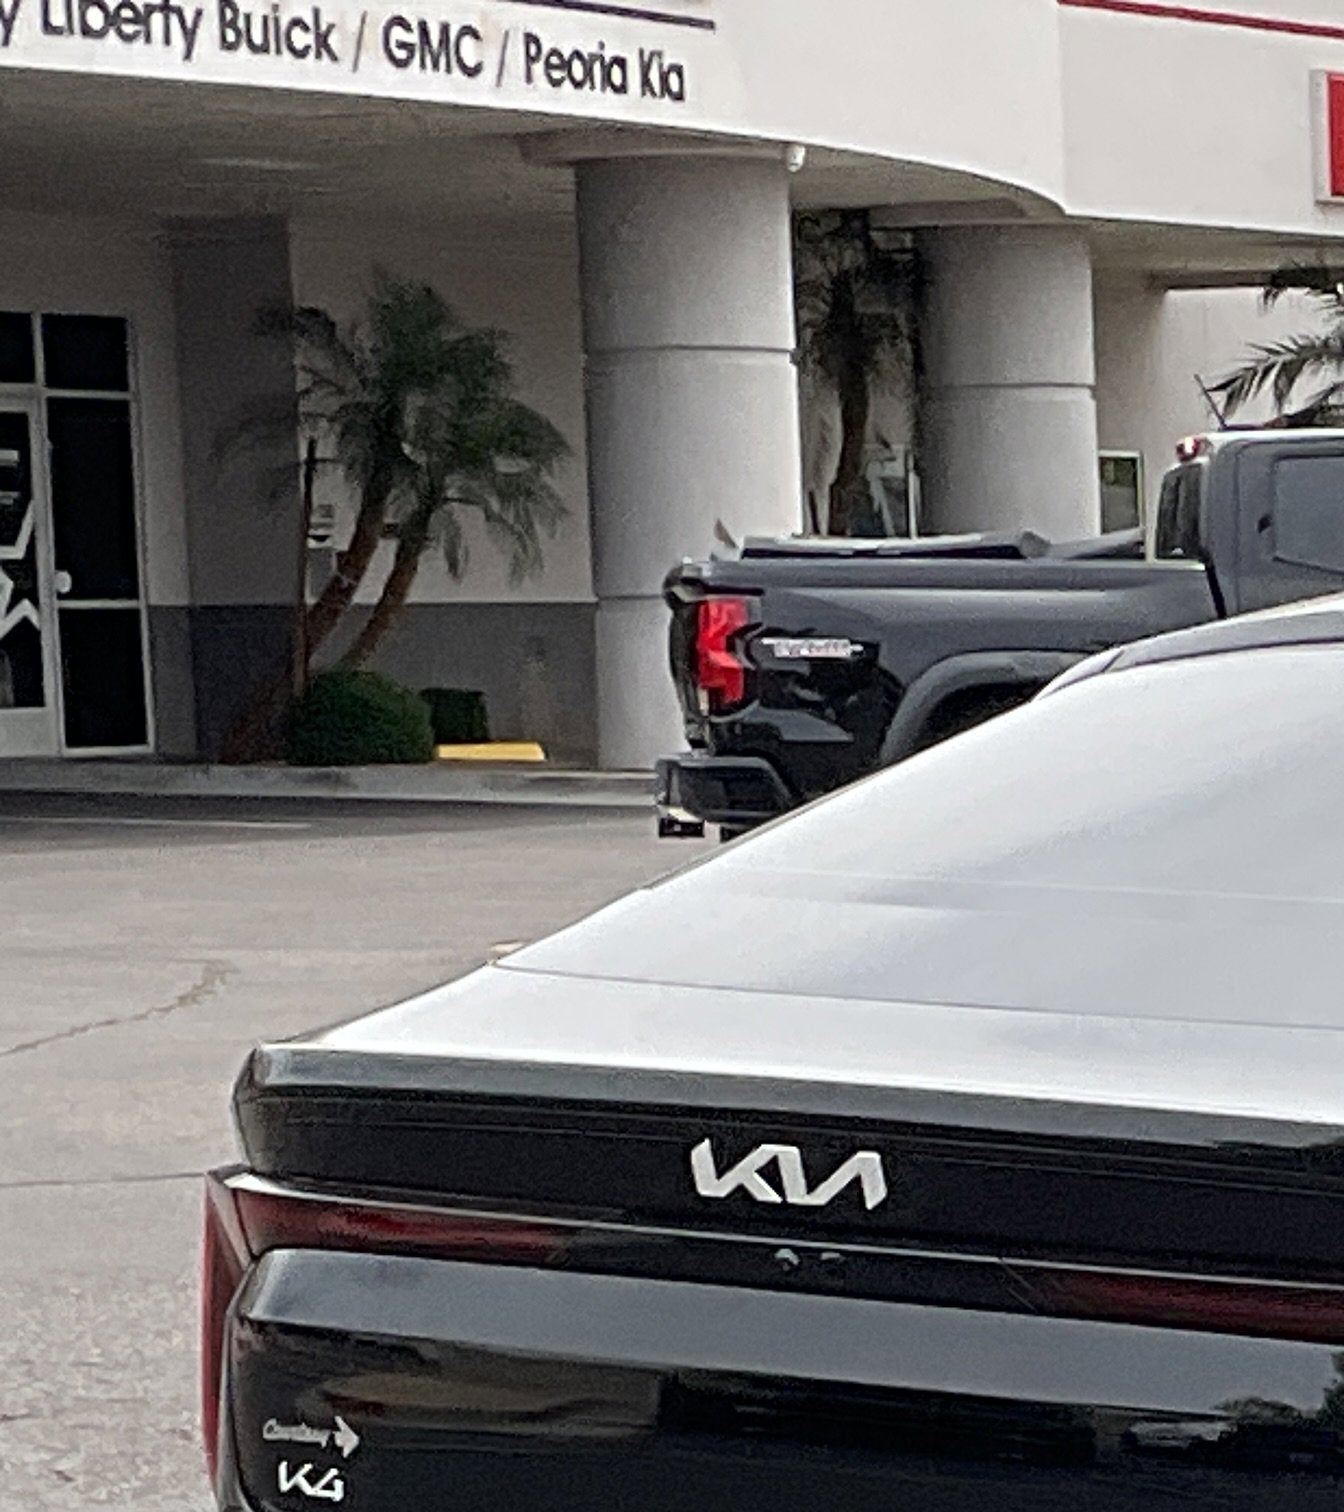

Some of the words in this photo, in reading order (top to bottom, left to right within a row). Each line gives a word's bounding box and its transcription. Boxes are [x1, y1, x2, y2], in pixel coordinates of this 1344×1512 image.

[218, 0, 339, 62] Buick
[382, 15, 483, 77] GMC
[523, 32, 628, 94] Peoria
[639, 47, 686, 102] Kia
[691, 1138, 888, 1210] KIA
[278, 1461, 344, 1502] K4
